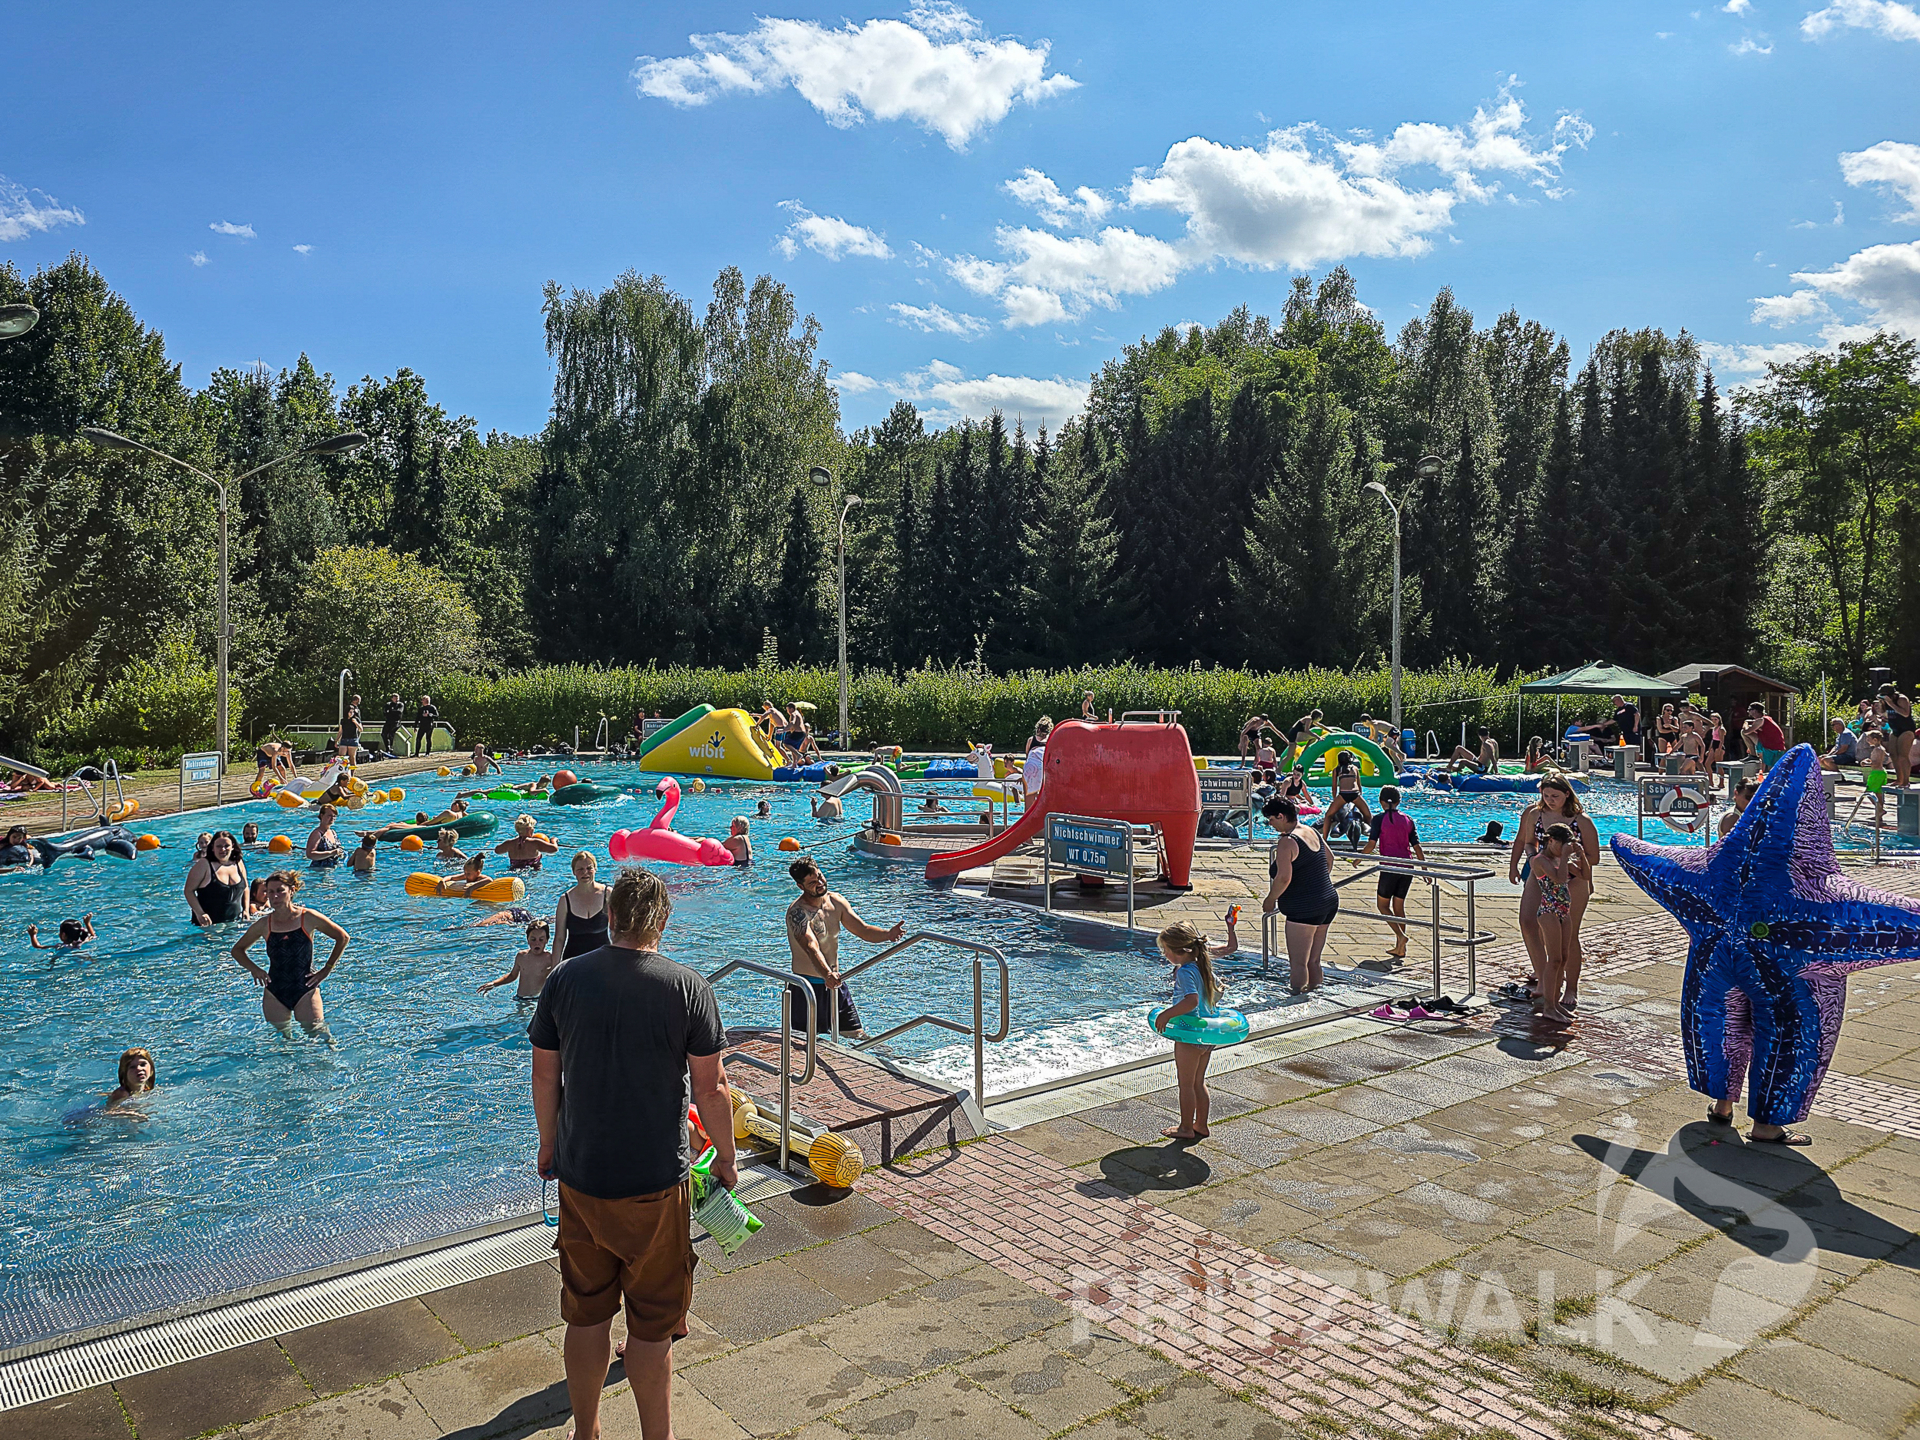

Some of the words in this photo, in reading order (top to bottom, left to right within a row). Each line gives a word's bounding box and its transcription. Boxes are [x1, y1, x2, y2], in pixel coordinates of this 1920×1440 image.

[689, 744, 725, 759] wibit
[1580, 752, 1587, 761] 6
[1824, 792, 1832, 802] 2
[1054, 825, 1120, 846] Nichtschwimmer
[1068, 848, 1080, 861] WT
